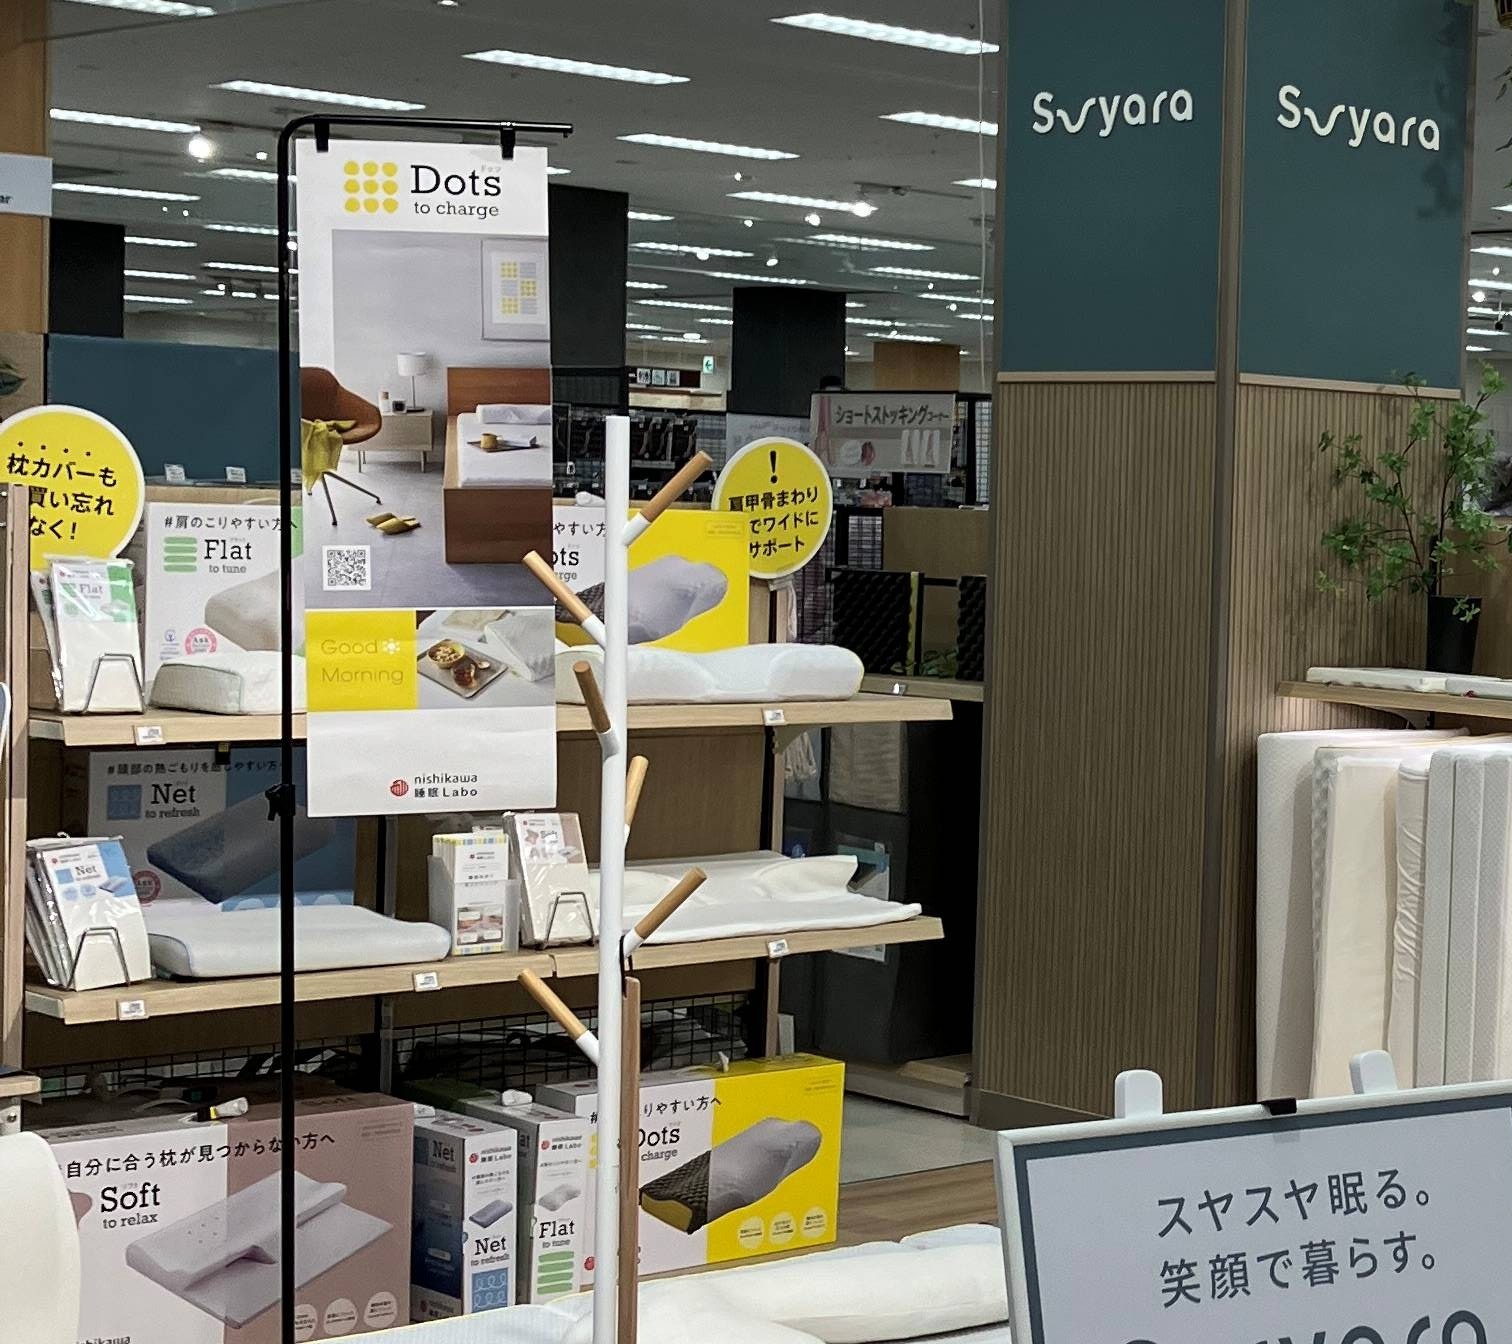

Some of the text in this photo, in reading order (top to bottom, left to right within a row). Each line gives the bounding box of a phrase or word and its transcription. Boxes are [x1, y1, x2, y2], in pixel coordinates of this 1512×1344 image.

[410, 164, 502, 197] Dots
[414, 202, 499, 220] to charge
[6, 452, 117, 487] 枕カバーも
[28, 485, 114, 516] 買い忘れ
[203, 538, 252, 561] Flat
[749, 536, 805, 558] サポート
[552, 548, 580, 566] ots
[208, 564, 247, 574] to tune
[320, 639, 379, 655] Good
[321, 668, 404, 686] Morning
[414, 773, 478, 784] nishikawa
[150, 784, 197, 805] Net
[442, 787, 478, 798] Labo
[145, 806, 200, 818] to refresh
[432, 1140, 455, 1162] Net
[100, 1183, 161, 1213] Soft
[1156, 1168, 1431, 1238] スヤスヤ眠る。
[103, 1213, 158, 1229] to relax
[539, 1220, 575, 1238] Flat
[475, 1237, 507, 1256] Net
[1159, 1230, 1435, 1308] 笑顔で暮らす。
